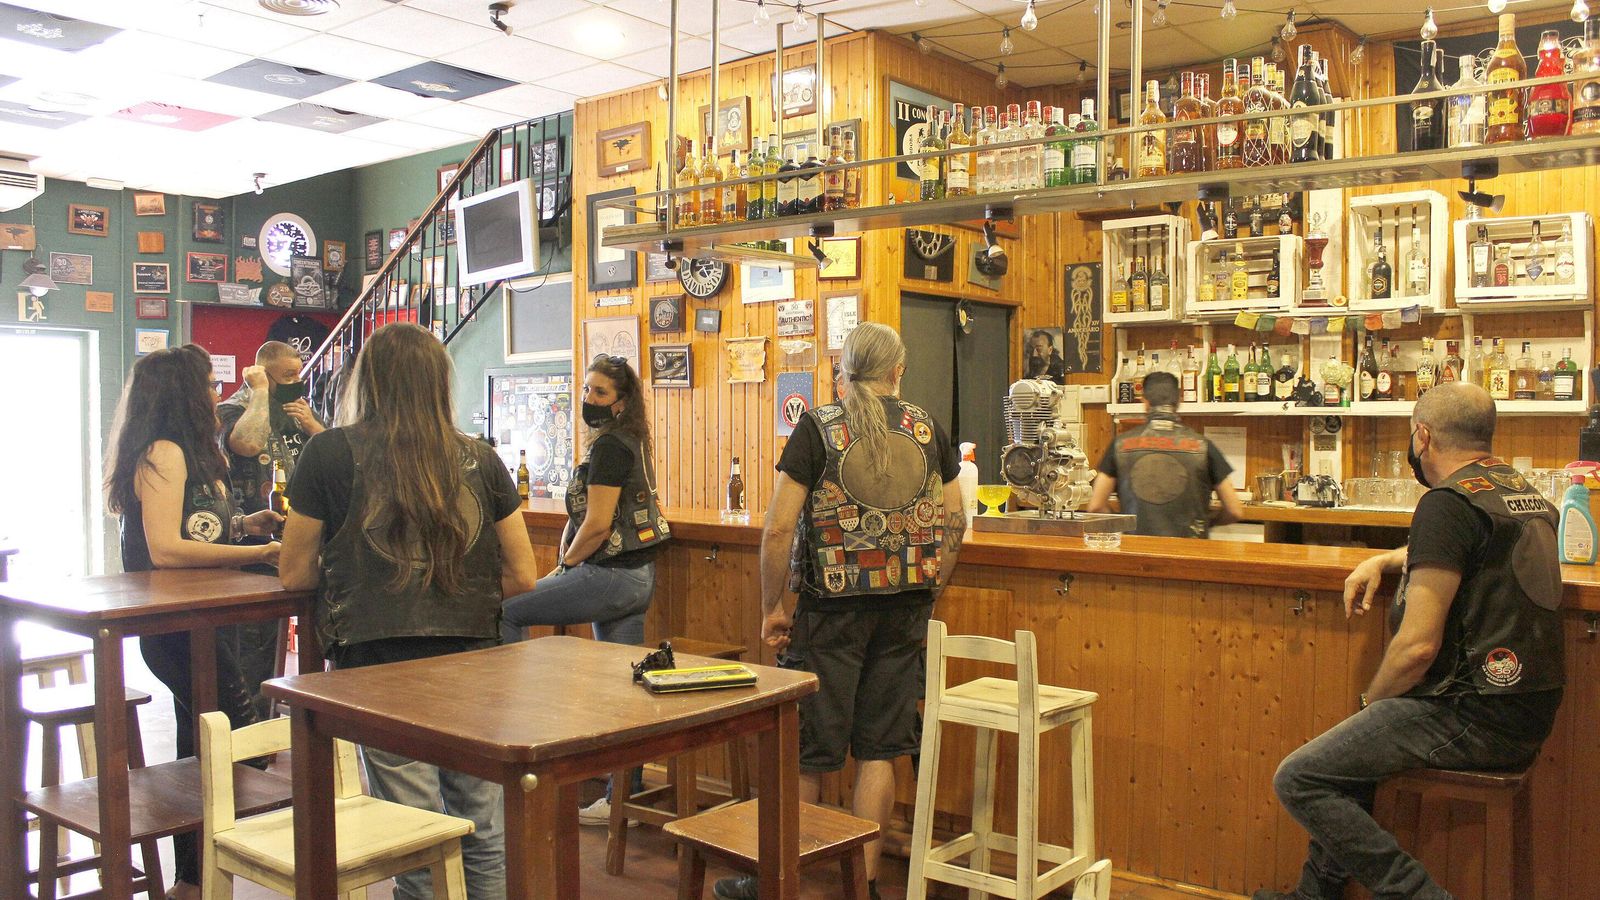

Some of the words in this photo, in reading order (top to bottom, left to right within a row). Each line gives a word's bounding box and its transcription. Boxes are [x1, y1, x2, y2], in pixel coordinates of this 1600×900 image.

[897, 101, 910, 121] II
[291, 336, 312, 353] 30
[1507, 495, 1548, 512] CHACÓN
